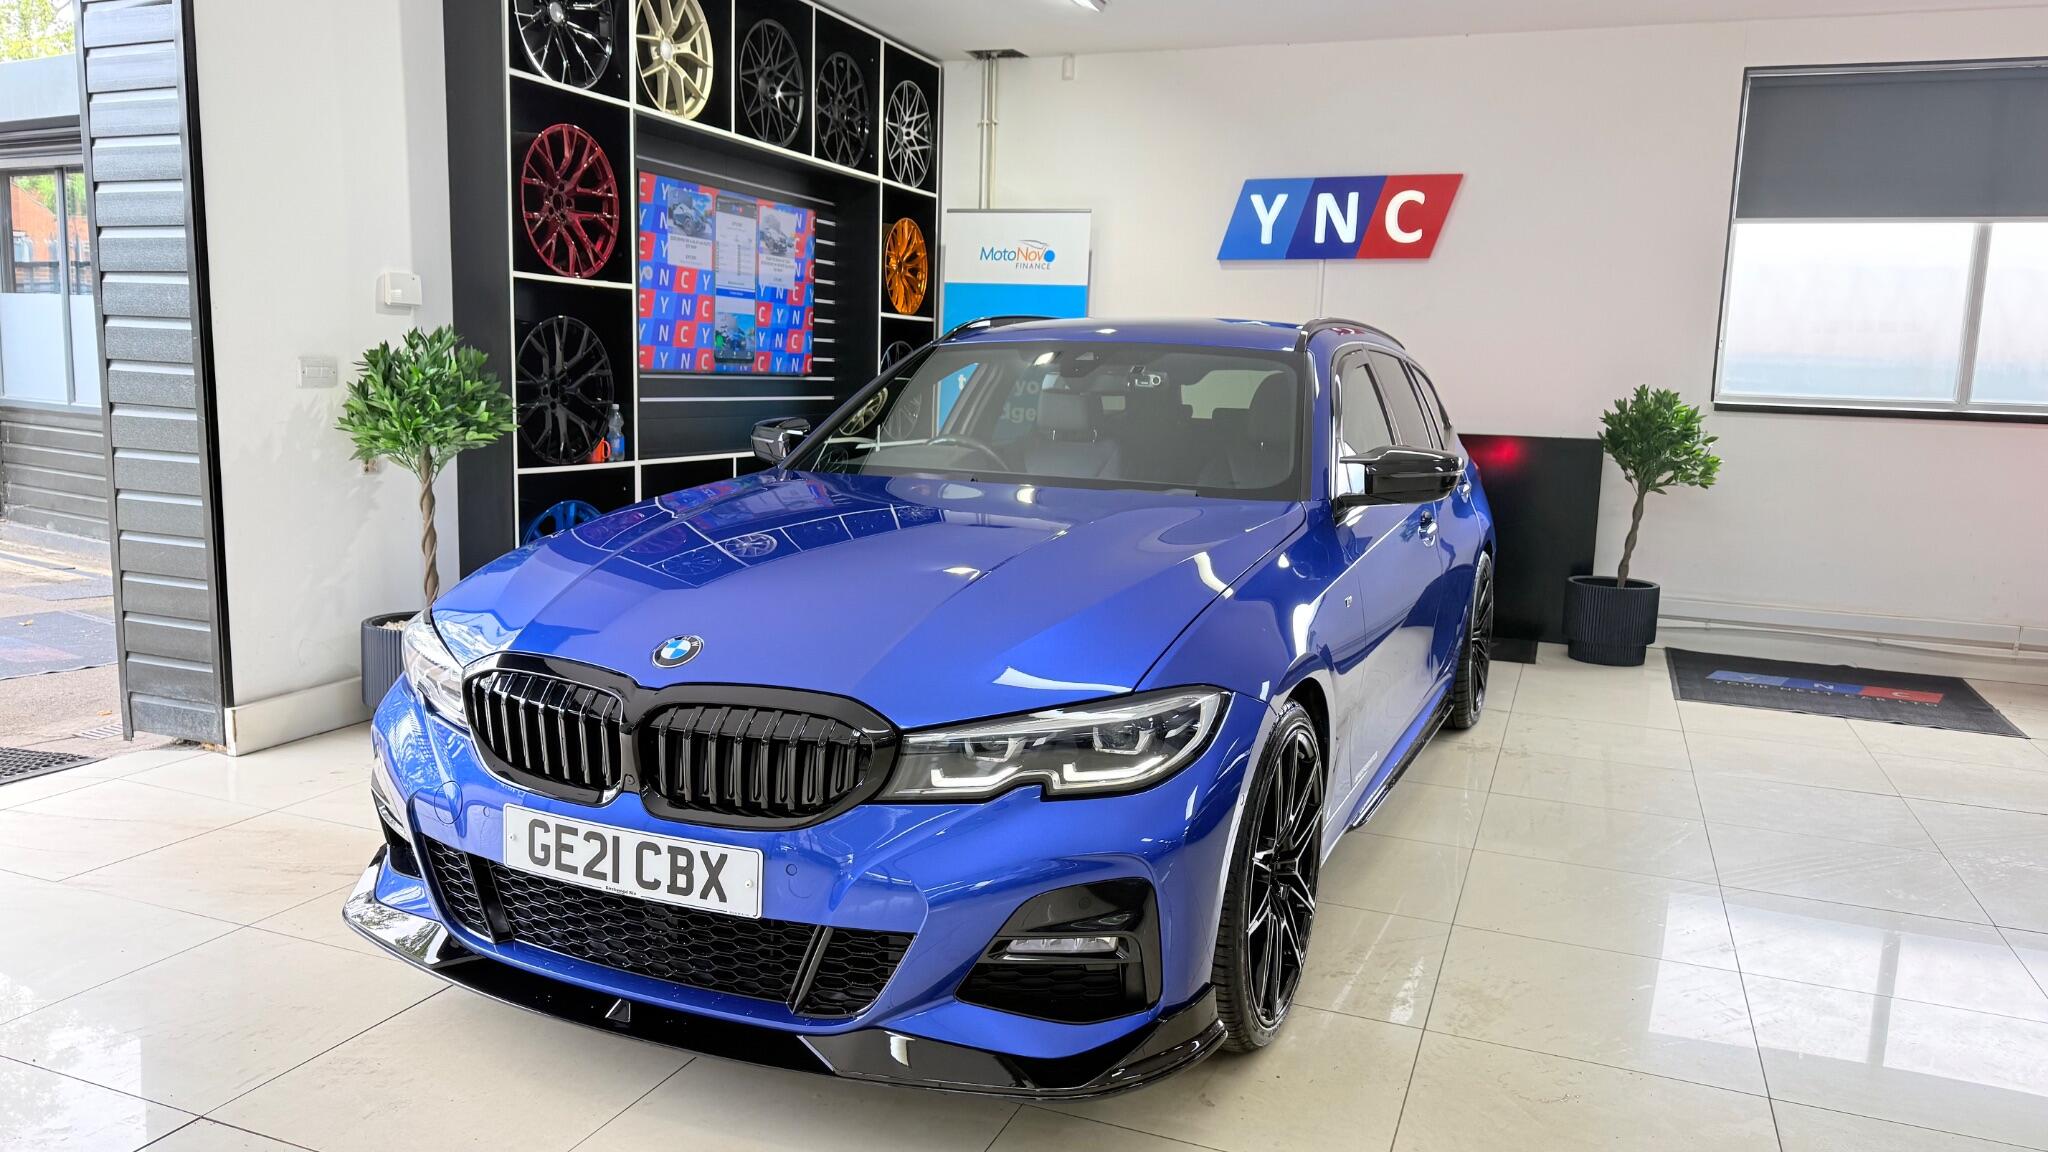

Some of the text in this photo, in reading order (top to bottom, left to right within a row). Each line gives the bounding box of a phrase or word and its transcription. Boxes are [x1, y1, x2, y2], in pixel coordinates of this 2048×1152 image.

[1250, 189, 1427, 245] YNC
[1015, 262, 1051, 270] FINANCE
[528, 818, 728, 903] GE21 CBX
